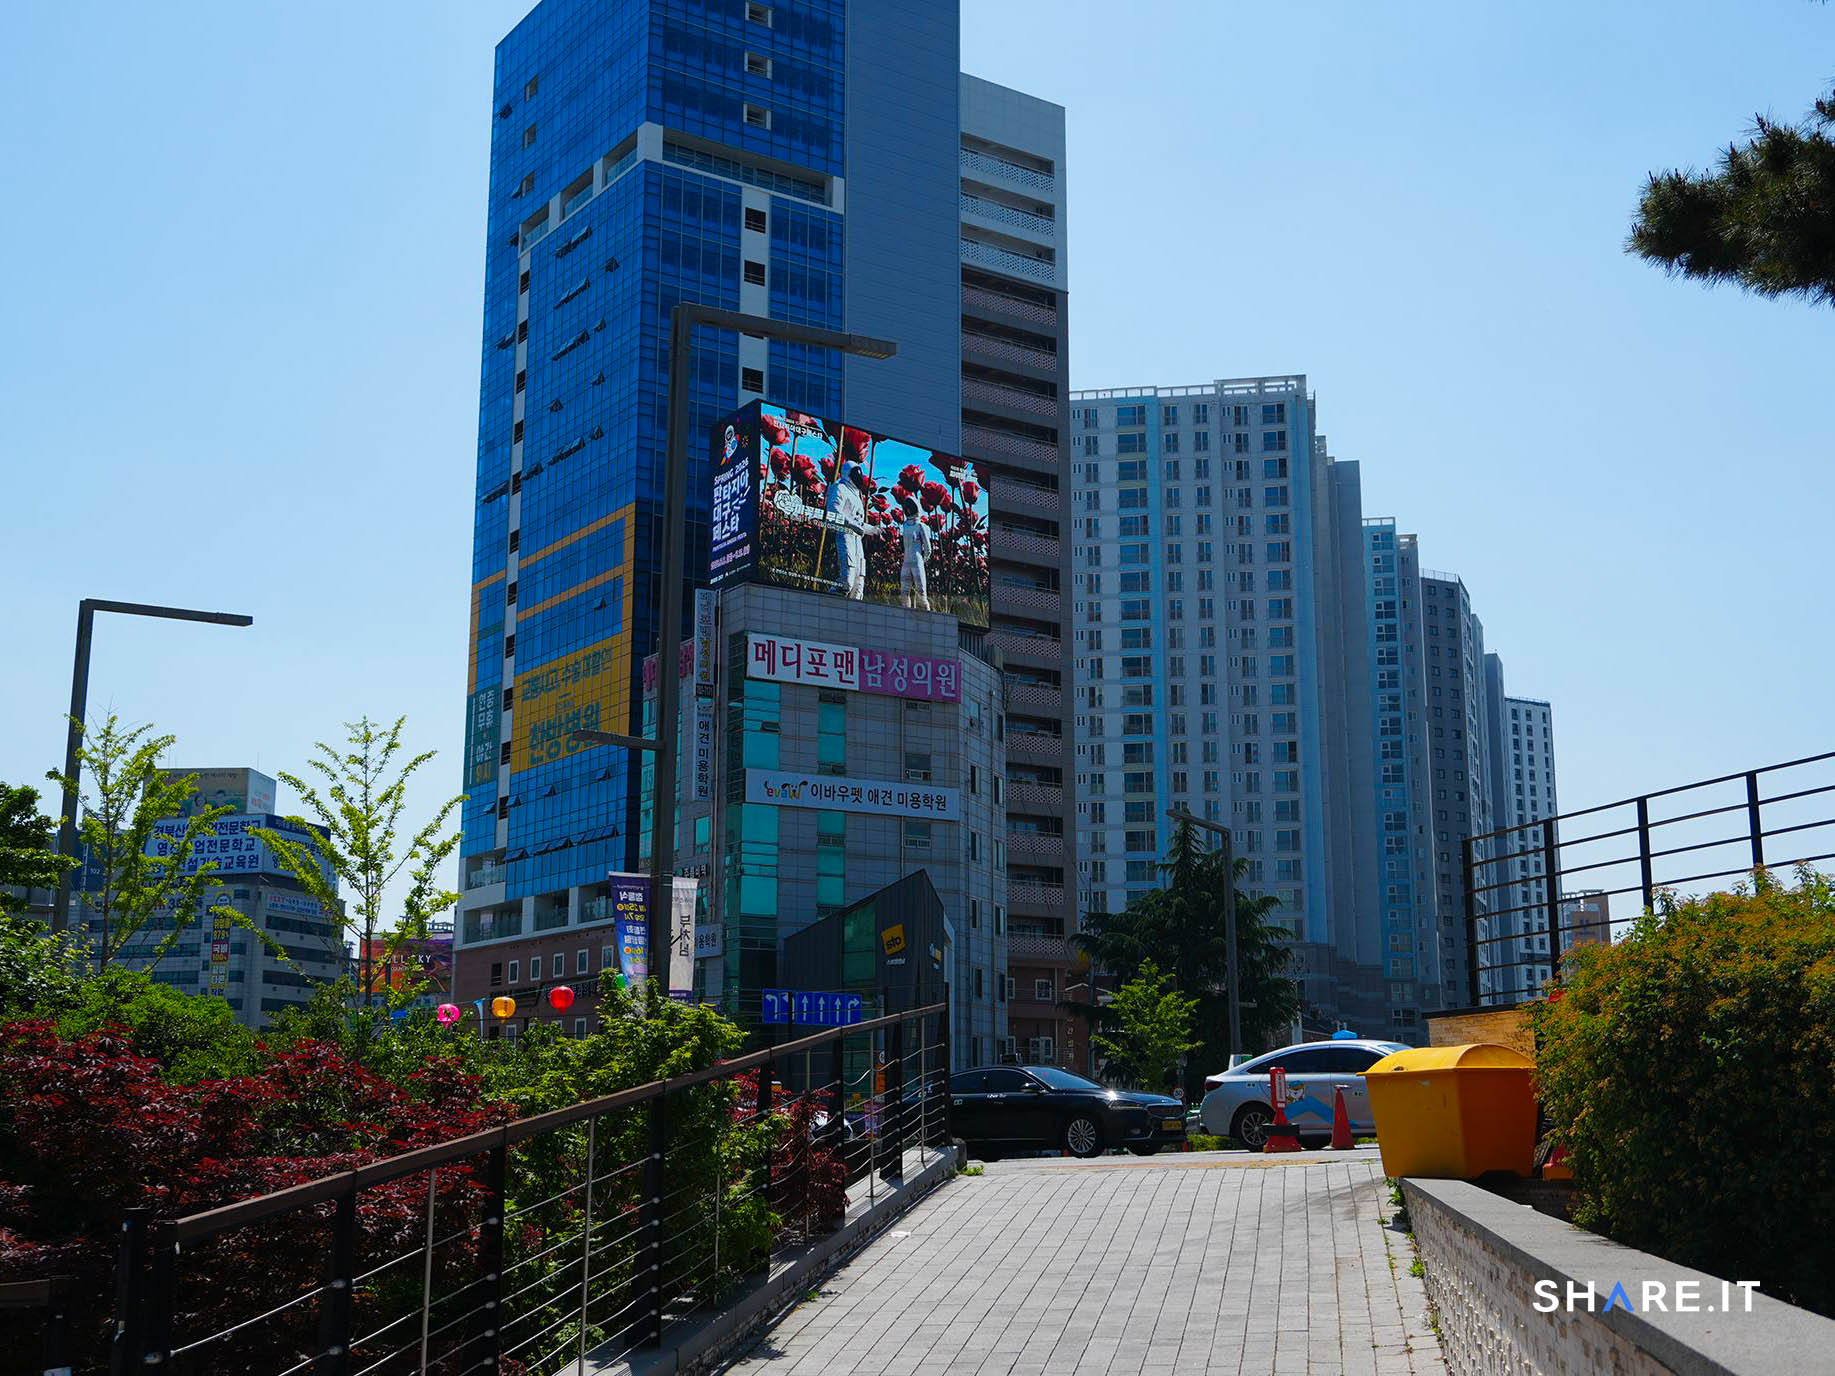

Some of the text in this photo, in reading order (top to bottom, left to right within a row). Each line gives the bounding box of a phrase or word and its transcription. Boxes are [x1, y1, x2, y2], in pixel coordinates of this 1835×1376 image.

[714, 468, 734, 485] SPRING
[714, 469, 750, 505] 판타지아
[713, 501, 731, 522] 대구
[713, 513, 739, 542] 페스타
[754, 639, 957, 698] 메디포맨 남성의원
[698, 720, 710, 745] 애견
[697, 748, 710, 798] 미용학원
[810, 782, 865, 804] 이바우펫
[868, 786, 893, 806] 애견
[897, 791, 947, 812] 미용학원
[696, 931, 718, 949] 용학원
